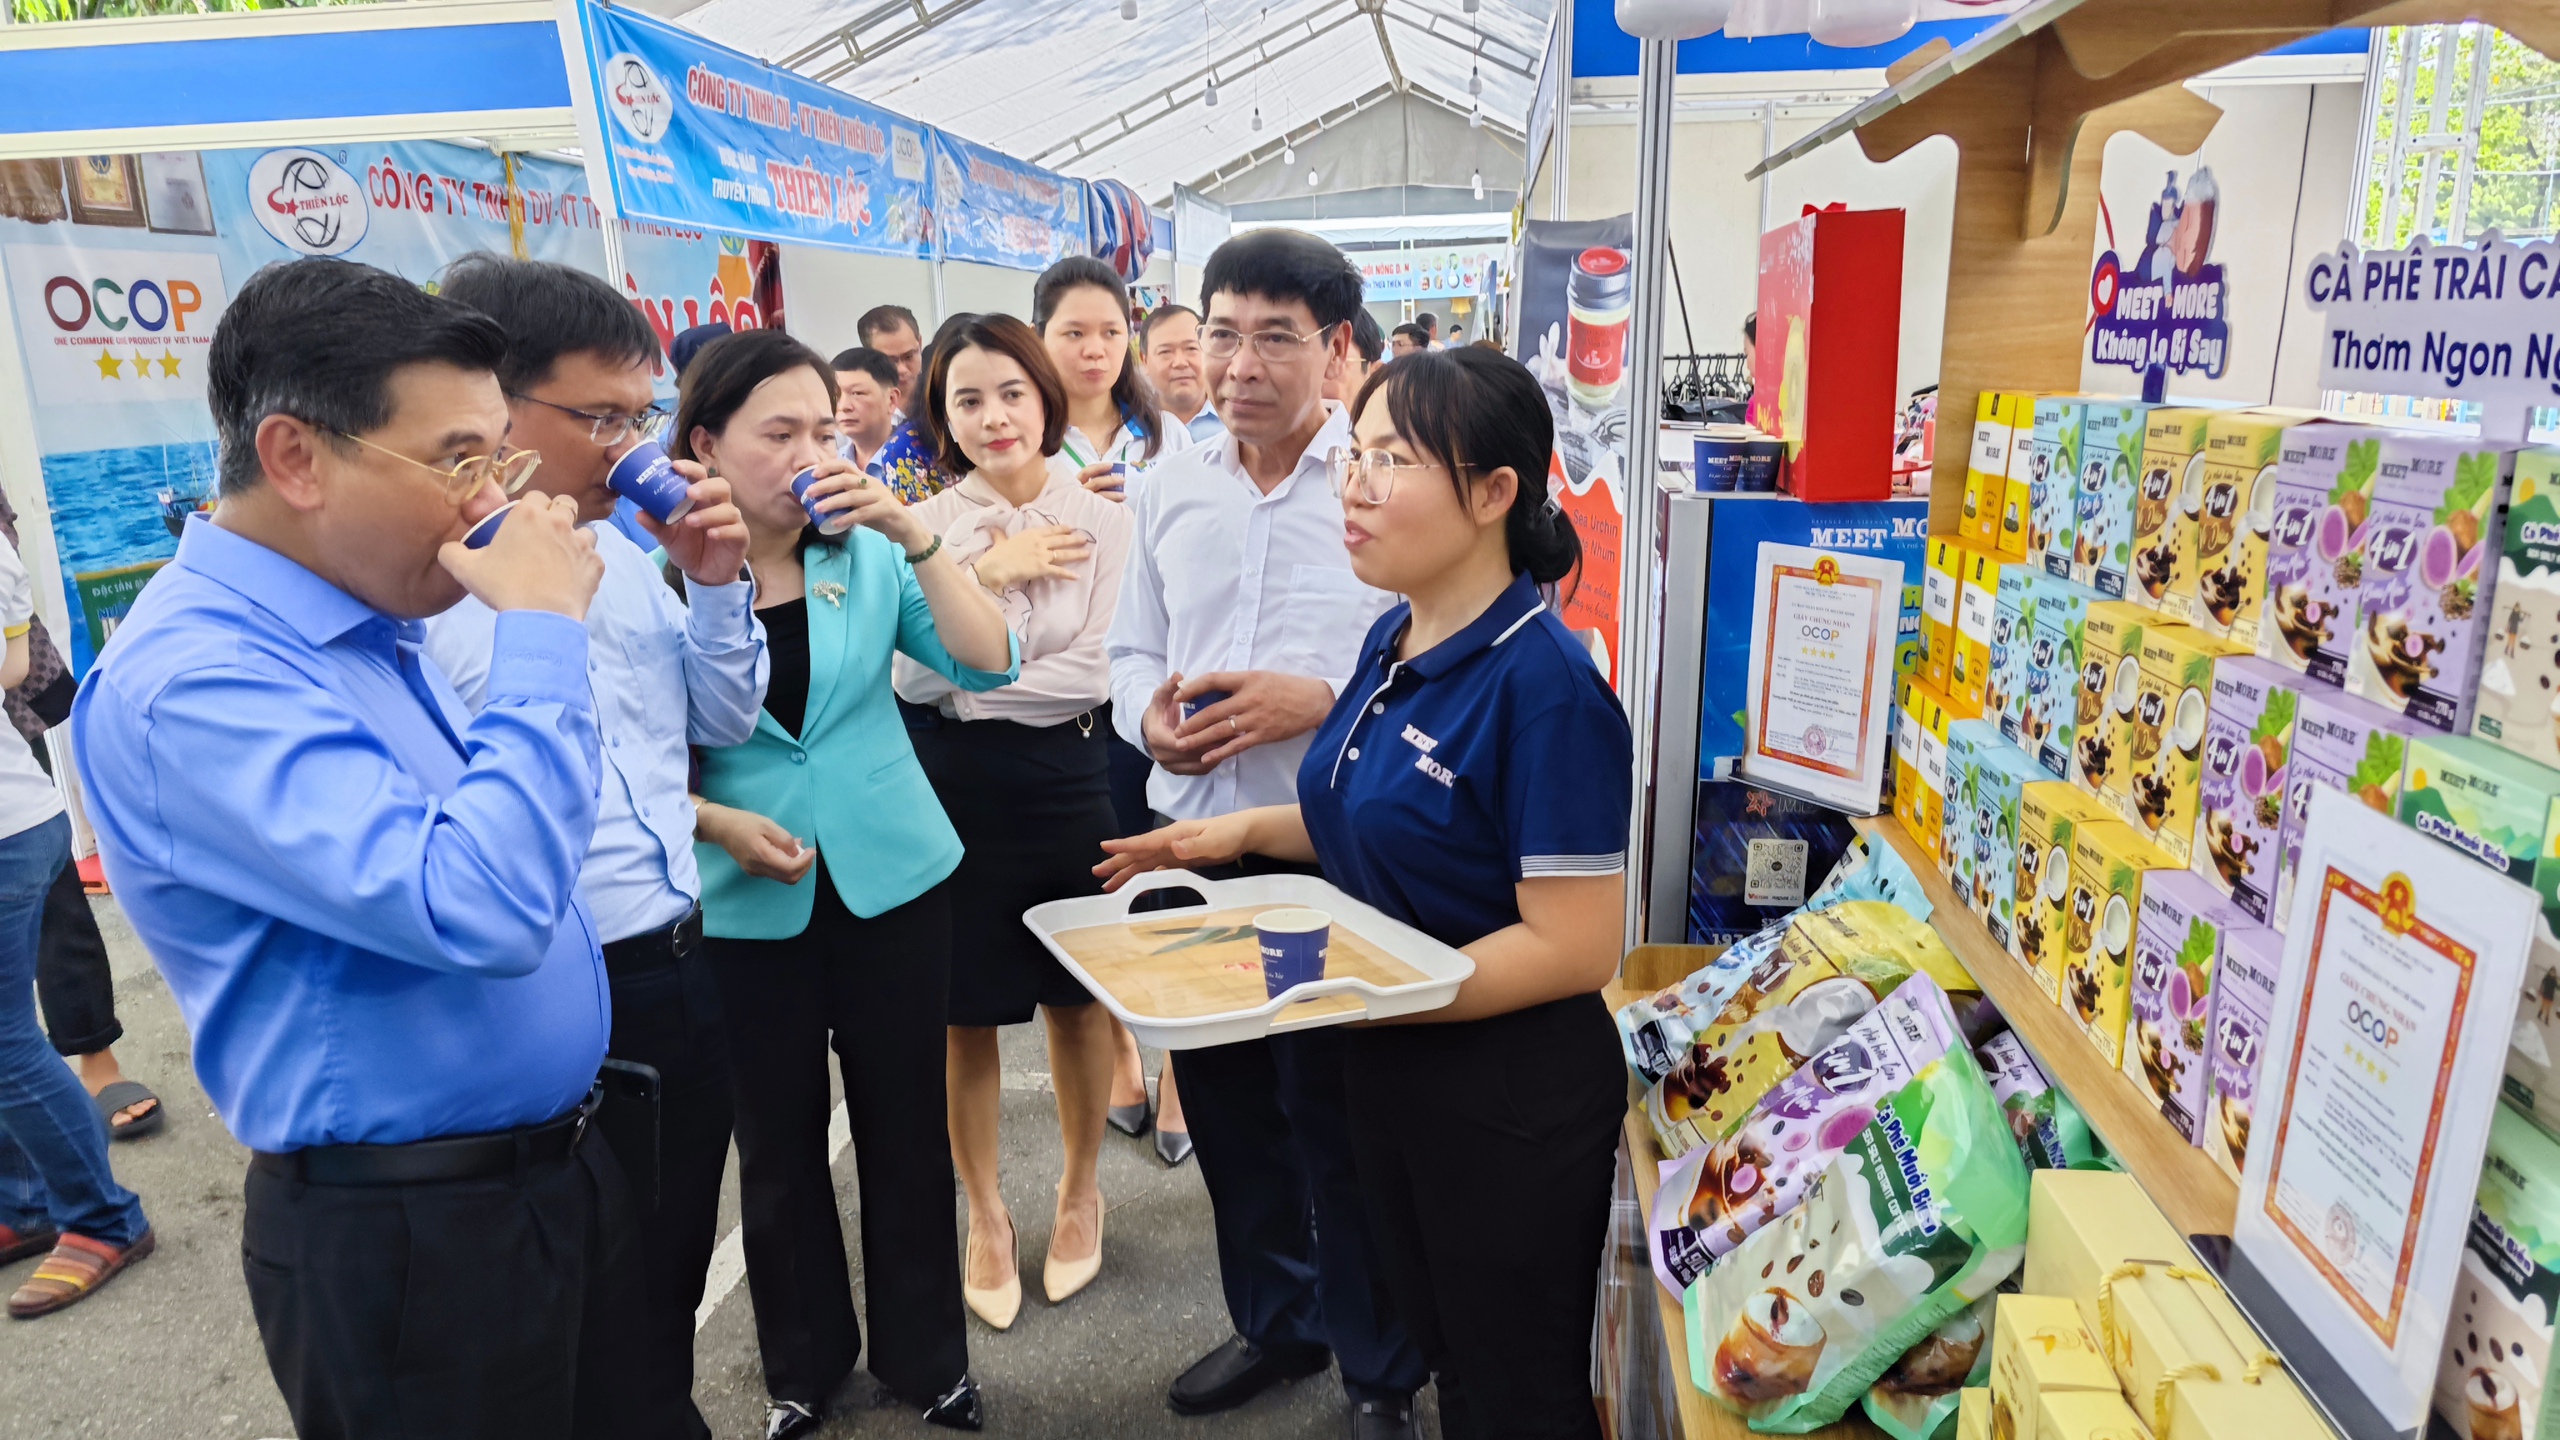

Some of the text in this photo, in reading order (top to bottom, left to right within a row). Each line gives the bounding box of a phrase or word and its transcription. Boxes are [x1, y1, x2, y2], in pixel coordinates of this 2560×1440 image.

[687, 62, 726, 112] CÔNG
[727, 78, 743, 118] TY
[744, 84, 776, 127] TNHH
[776, 96, 791, 132] DV
[798, 102, 813, 137] VT
[813, 106, 842, 147] THIÊN
[841, 115, 868, 154] THIÊN
[866, 120, 885, 161] LỘC
[300, 193, 349, 211] THIÊN LỘC
[368, 157, 433, 214] CÔNG
[439, 177, 467, 216] TY
[472, 183, 527, 223] TNHH
[712, 177, 746, 203] TRUYỀN
[766, 154, 872, 237] THIÊN LỘC
[1375, 262, 1395, 275] NÔNG
[1396, 263, 1410, 275] DN
[2310, 251, 2352, 303] CÀ
[2363, 246, 2423, 302] PHÊ
[2433, 240, 2507, 301] TRÁI
[45, 275, 202, 332] OCOP
[2116, 282, 2219, 320] MEET MORE
[54, 337, 68, 346] ONE
[70, 336, 114, 345] COMMUNE
[128, 336, 162, 345] PRODUCT
[163, 337, 172, 345] OF
[174, 336, 190, 345] VIET
[2096, 328, 2223, 374] Không Lo Bị Say
[2332, 330, 2411, 371] Thơm
[2422, 331, 2512, 388] Ngon
[1978, 431, 1990, 442] MEET
[2087, 416, 2119, 431] MEET MORE
[2149, 425, 2182, 438] MEET MORE
[1986, 447, 2000, 459] MORE
[2209, 435, 2247, 450] MEET MORE
[2282, 445, 2338, 465] MEET MORE
[2083, 465, 2106, 491] 4in1
[2381, 457, 2445, 479] MEET MORE
[2142, 470, 2172, 501] 4in1
[2205, 483, 2237, 518] 4in1
[1573, 508, 1618, 538] Sea Urchin
[1809, 517, 1929, 549] MEET MO
[2274, 508, 2314, 547] 4in1
[1591, 540, 1616, 564] Nhum
[2369, 528, 2416, 572] 4in1
[1929, 576, 1938, 590] MEET
[1934, 593, 1947, 608] MORE
[1965, 592, 1976, 607] MEET
[2038, 597, 2066, 612] MEET MORE
[1801, 625, 1839, 641] OCOP
[1972, 611, 1985, 627] MORE
[1994, 618, 2011, 644] 4in1
[2032, 640, 2053, 669] 4in1
[2143, 646, 2175, 664] MEET MORE
[2083, 661, 2106, 693] 4in1
[2214, 678, 2259, 702] MEET MORE
[2138, 692, 2165, 726] 4in1
[2300, 718, 2359, 745] MEET MORE
[1414, 754, 1457, 789] MOR
[1929, 758, 1941, 777] MORE
[2207, 739, 2239, 775] 4in1
[2440, 769, 2502, 798] MEET MORE
[1977, 807, 1992, 838] 4in1
[2418, 814, 2429, 830] Cà
[2432, 818, 2451, 838] Phê
[2455, 828, 2480, 851] Muối
[2020, 840, 2038, 874] 4in1
[2076, 841, 2104, 867] MEET MORE
[2073, 886, 2095, 923] 4in1
[2143, 892, 2185, 927] MEET MORE
[2137, 949, 2166, 993] 4in1
[2225, 954, 2275, 995] MEET MORE
[2348, 1000, 2398, 1049] OCOP
[2219, 1018, 2255, 1067] 4in1
[1862, 1127, 1874, 1145] SEA
[1868, 1143, 1882, 1165] SALT
[1884, 1118, 1909, 1151] Phê
[1898, 1148, 1929, 1191] Muối
